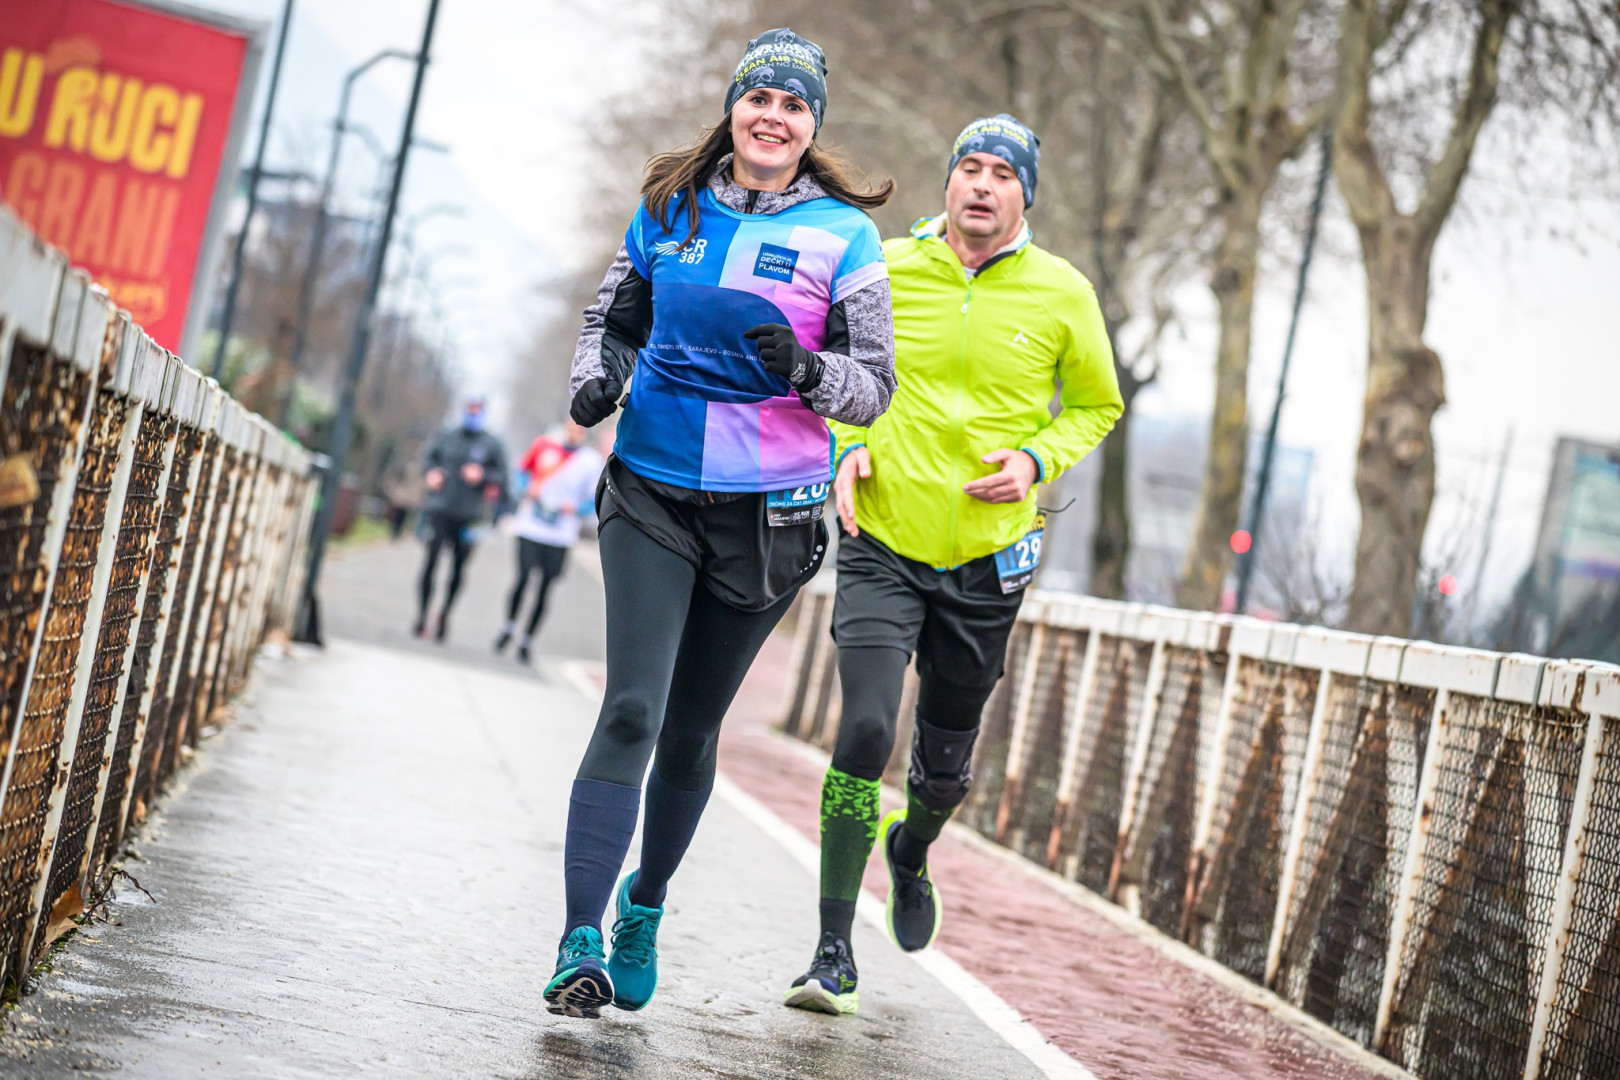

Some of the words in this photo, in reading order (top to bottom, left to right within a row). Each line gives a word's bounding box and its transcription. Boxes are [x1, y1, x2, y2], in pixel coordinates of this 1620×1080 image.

[735, 57, 766, 82] CLEAN
[770, 54, 791, 62] AIR
[794, 58, 818, 75] NOW
[0, 49, 44, 138] U
[44, 66, 203, 180] RUCI
[679, 252, 705, 264] 387
[758, 262, 790, 275] PLAVOM
[687, 345, 717, 354] SARAJEVO
[722, 349, 744, 359] BOSNIA
[745, 354, 757, 362] AND
[1015, 537, 1041, 569] 29
